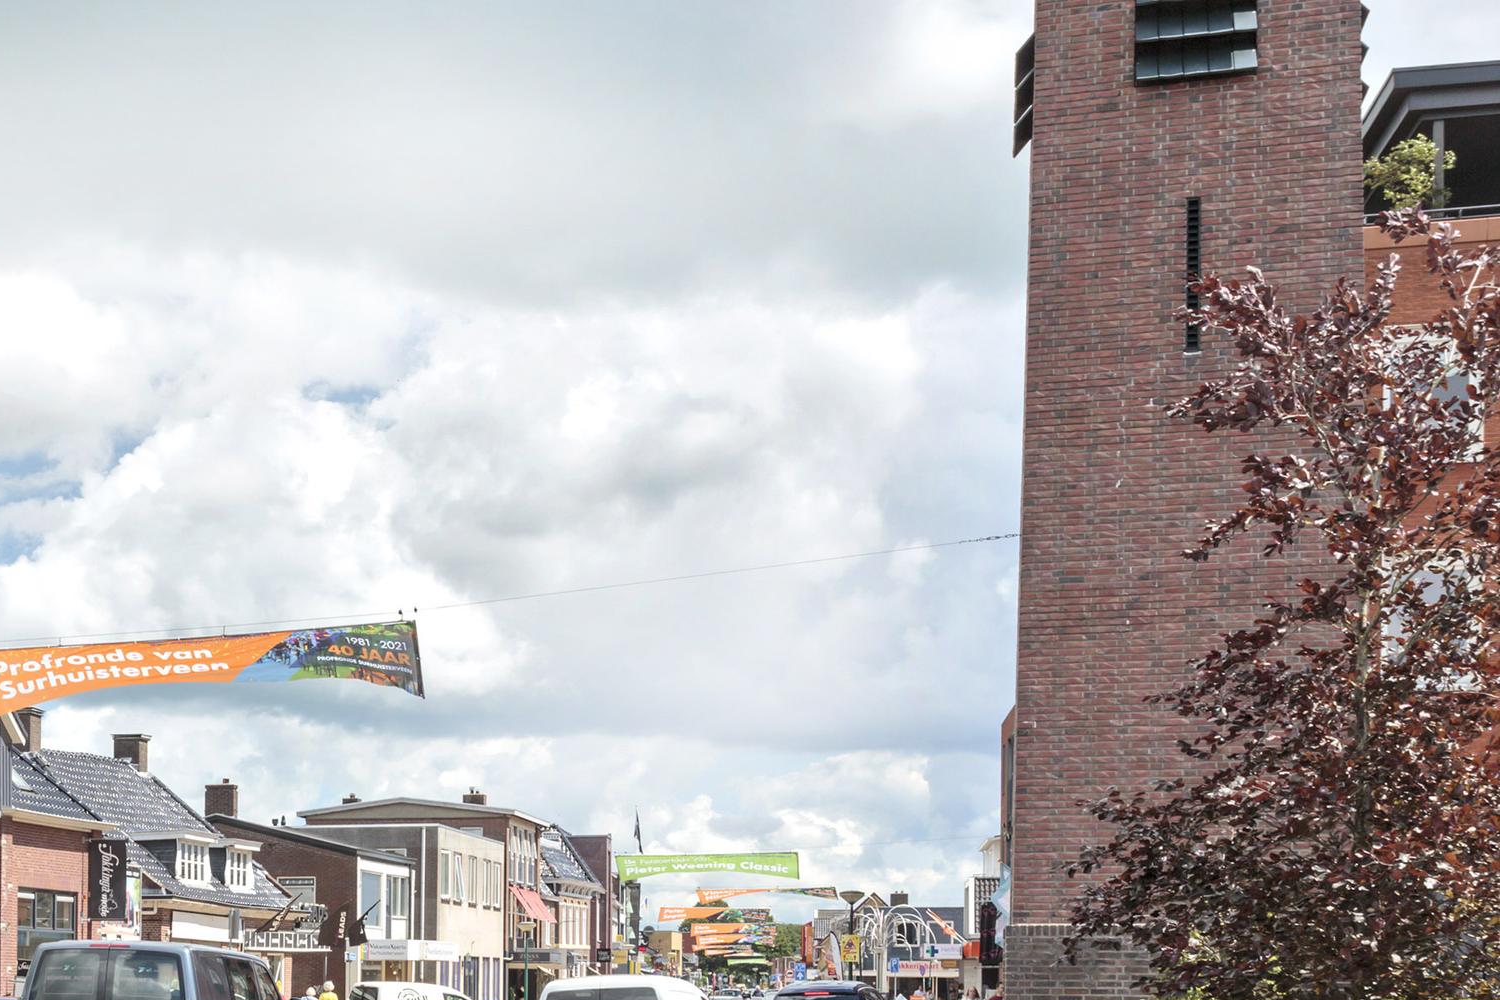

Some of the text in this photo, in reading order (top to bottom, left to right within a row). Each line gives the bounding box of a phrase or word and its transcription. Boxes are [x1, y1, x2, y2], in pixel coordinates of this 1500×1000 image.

[345, 637, 371, 647] 1981
[379, 640, 407, 651] 2021
[152, 648, 213, 661] van
[316, 656, 357, 664] PROFRONDE
[328, 645, 411, 665] 40 JAAR
[625, 865, 668, 876] Pieter
[672, 861, 736, 871] Weening
[740, 861, 789, 874] Classic
[338, 911, 347, 939] LEADS
